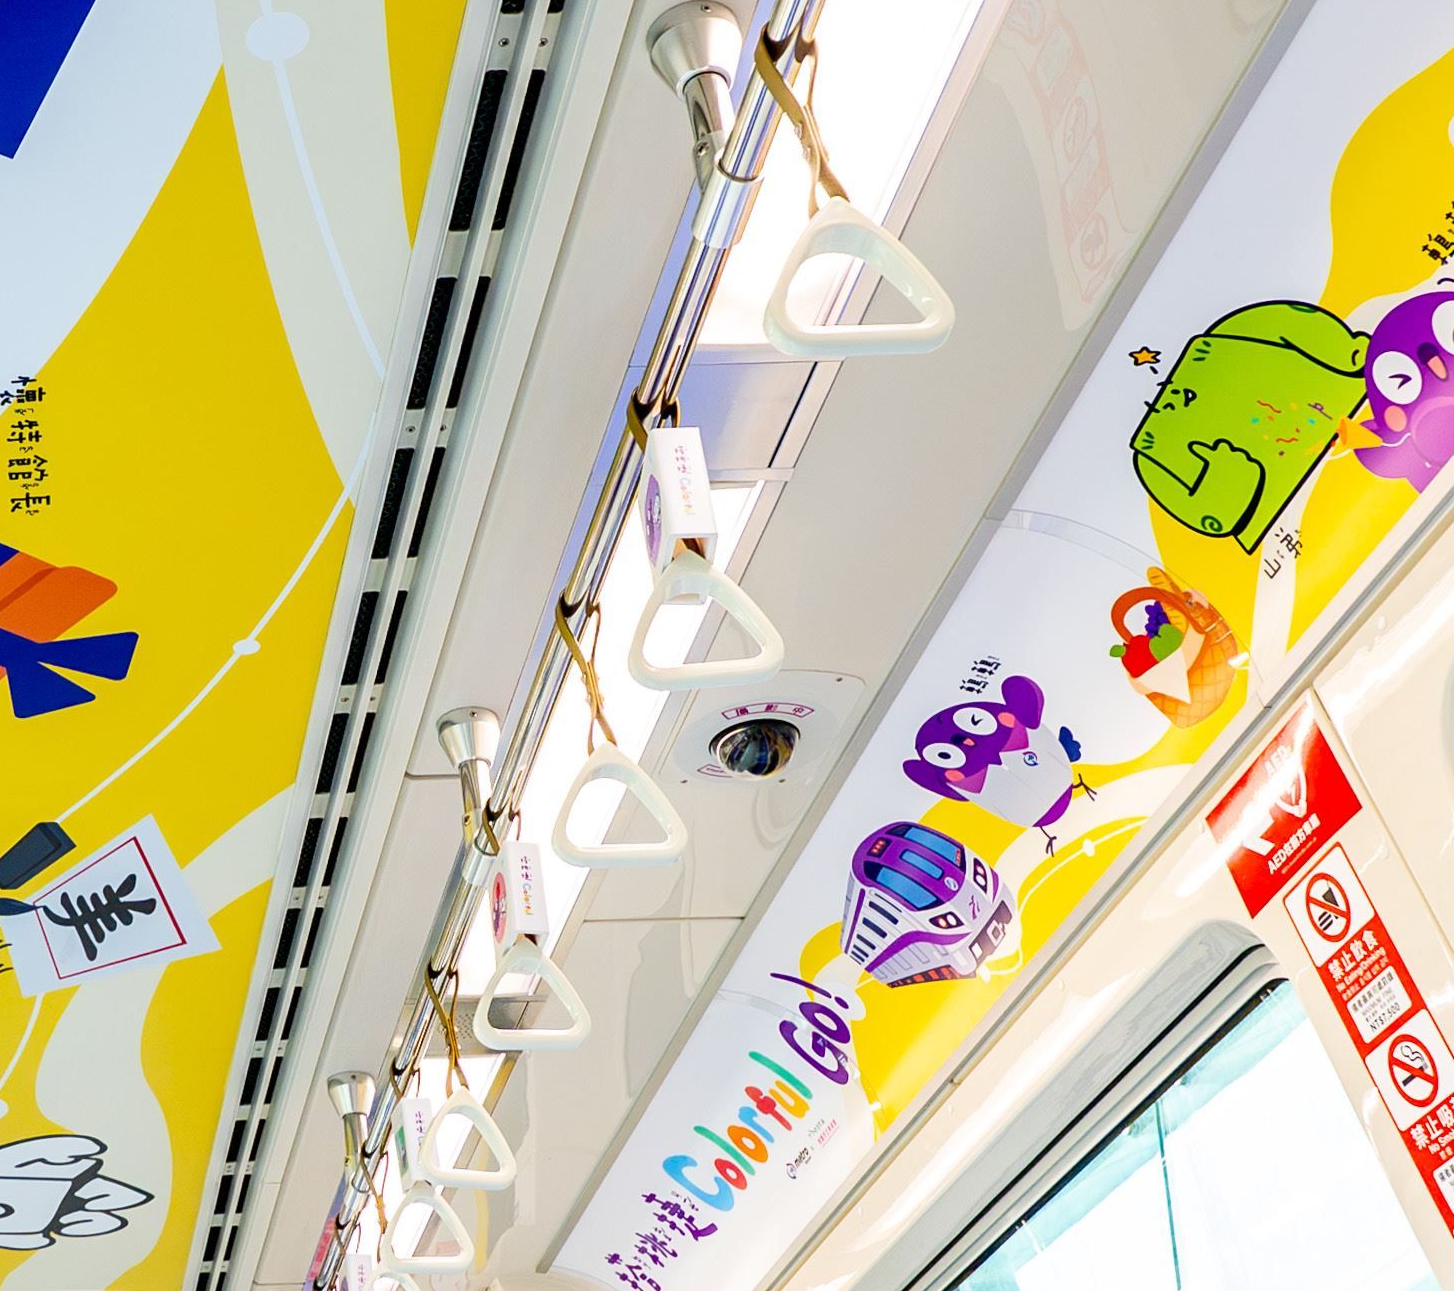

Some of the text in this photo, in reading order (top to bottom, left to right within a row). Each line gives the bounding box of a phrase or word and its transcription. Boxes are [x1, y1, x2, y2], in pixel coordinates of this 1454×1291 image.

[1327, 929, 1379, 982] 禁止飲食
[769, 971, 852, 1086] Go!
[662, 1050, 813, 1213] Colorful
[1428, 1143, 1440, 1154] No
